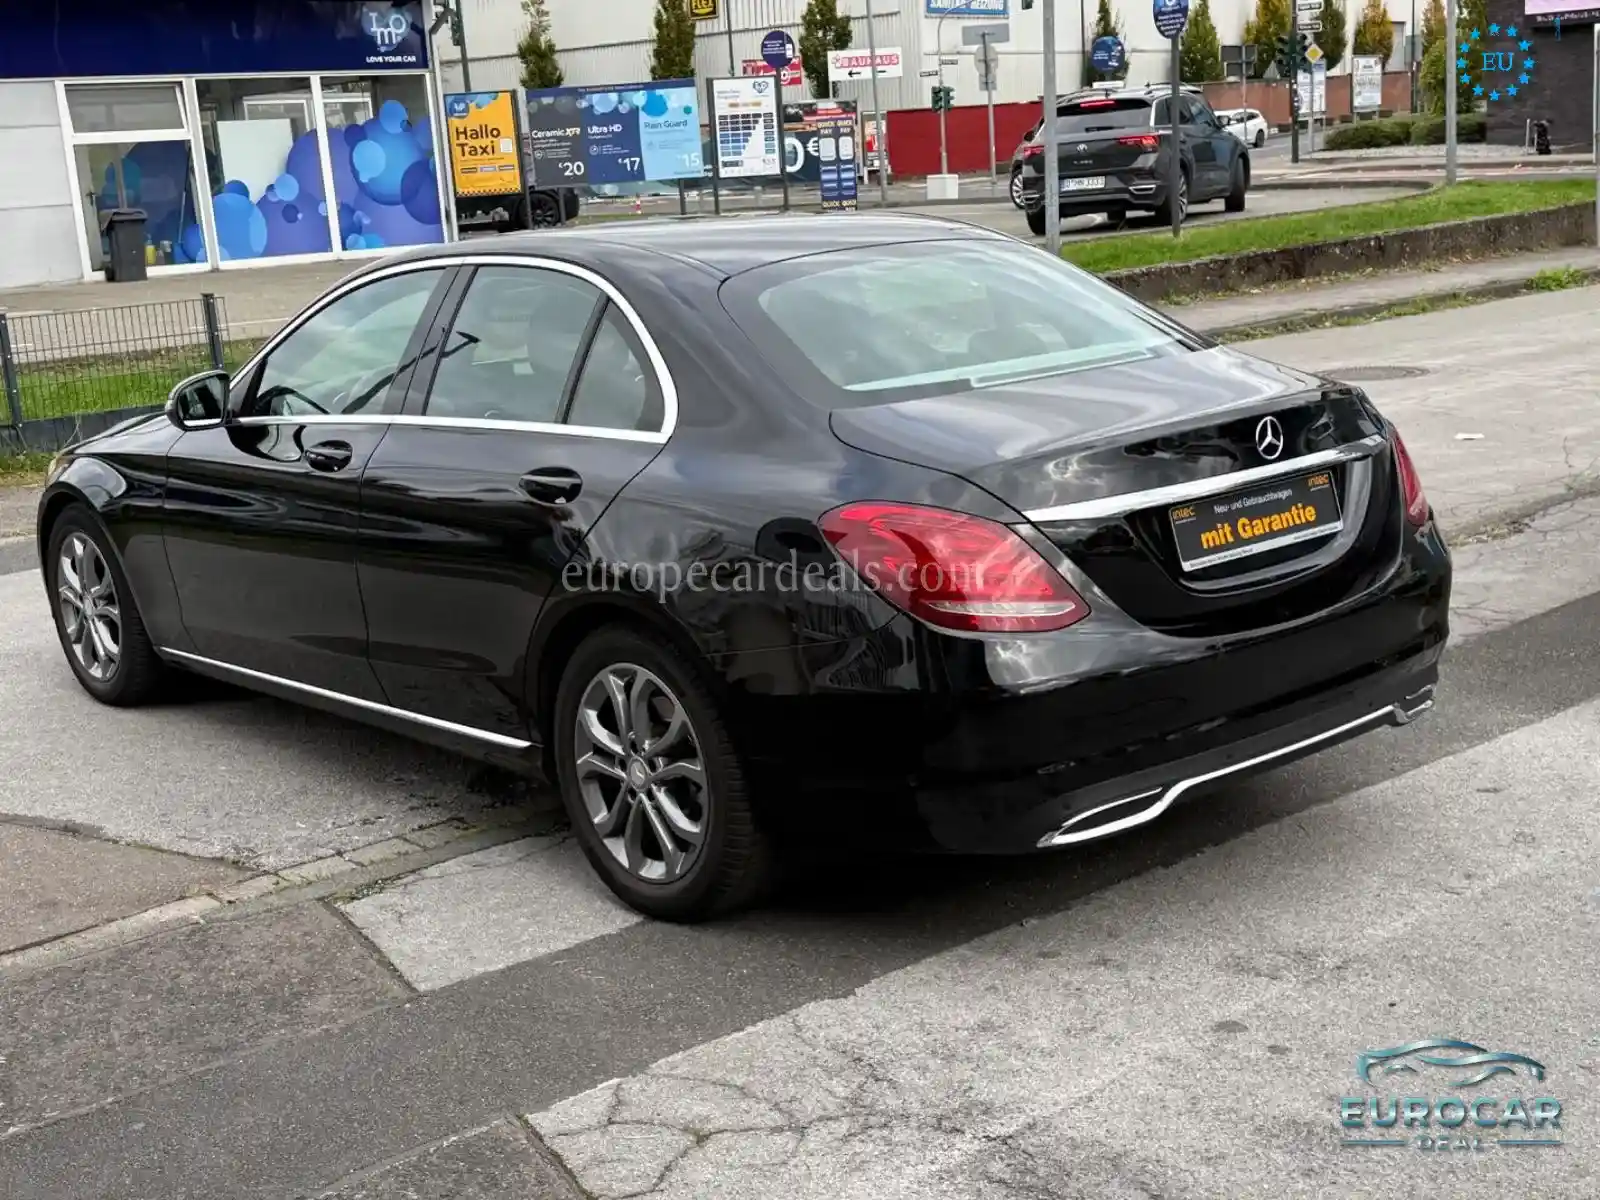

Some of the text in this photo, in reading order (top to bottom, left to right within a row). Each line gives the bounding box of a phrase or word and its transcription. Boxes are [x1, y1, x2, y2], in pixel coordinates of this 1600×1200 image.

[587, 124, 623, 134] Ultra HD
[644, 119, 688, 129] Rain Guard
[456, 124, 501, 141] Hallo
[532, 129, 564, 138] Ceramic
[456, 140, 495, 157] Taxi
[1308, 475, 1329, 487] intec
[1213, 489, 1293, 514] Neu- und Gebrauchtwagen
[1172, 506, 1196, 520] intec
[1201, 522, 1235, 550] mit
[1237, 502, 1317, 539] Garantie
